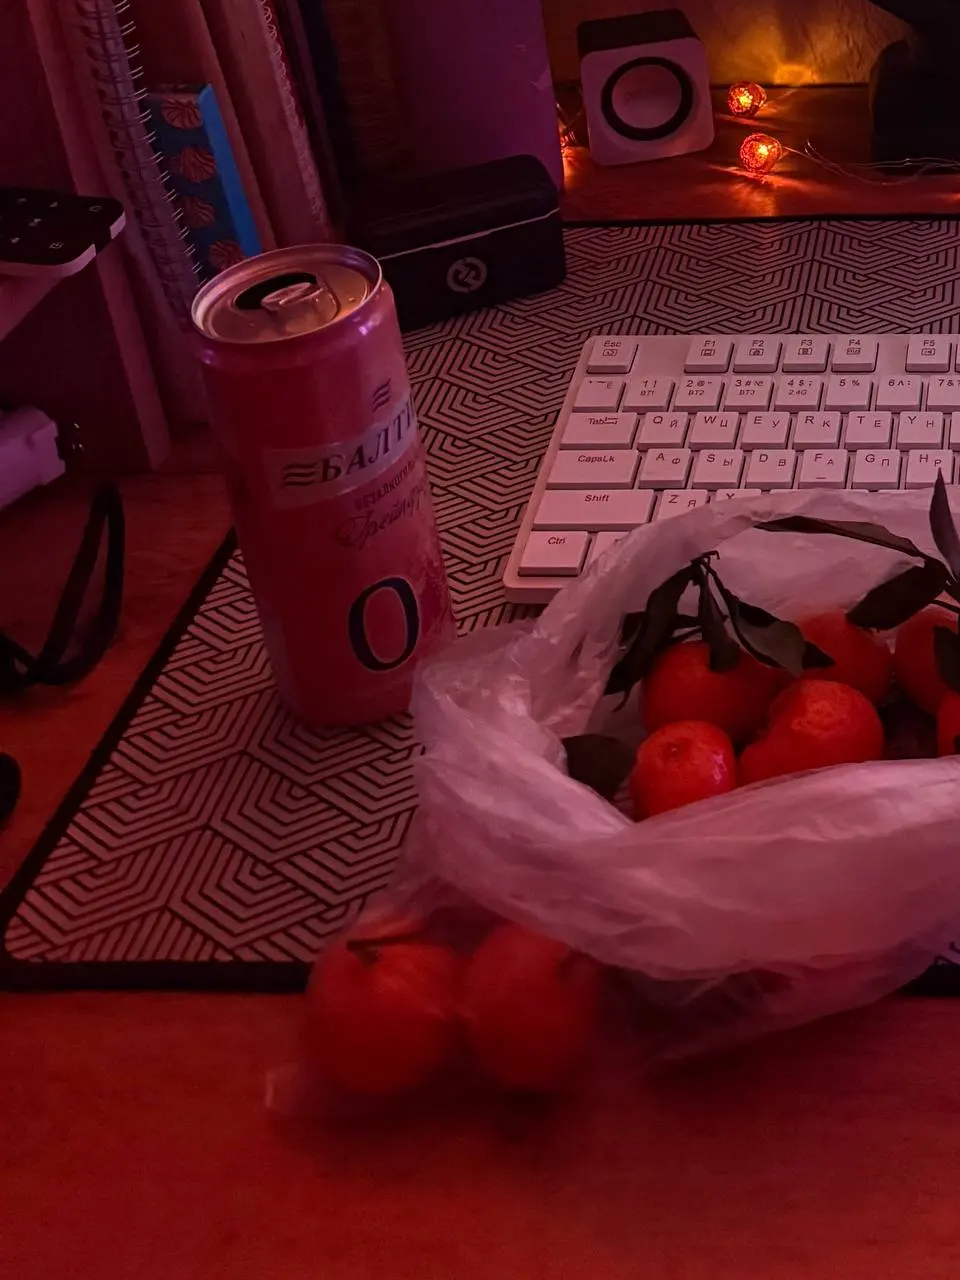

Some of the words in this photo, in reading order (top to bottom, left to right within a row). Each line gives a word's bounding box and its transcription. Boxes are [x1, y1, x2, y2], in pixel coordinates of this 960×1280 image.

[603, 340, 622, 348] Esc
[653, 416, 663, 424] Q
[704, 416, 717, 424] W
[805, 416, 815, 424] R
[908, 416, 917, 424] Y
[706, 454, 716, 463] S
[759, 454, 769, 463] D
[815, 453, 823, 462] F
[865, 454, 875, 463] G
[919, 454, 928, 463] H
[585, 494, 610, 503] Shift
[669, 495, 680, 503] Z
[548, 536, 566, 545] Ctrl
